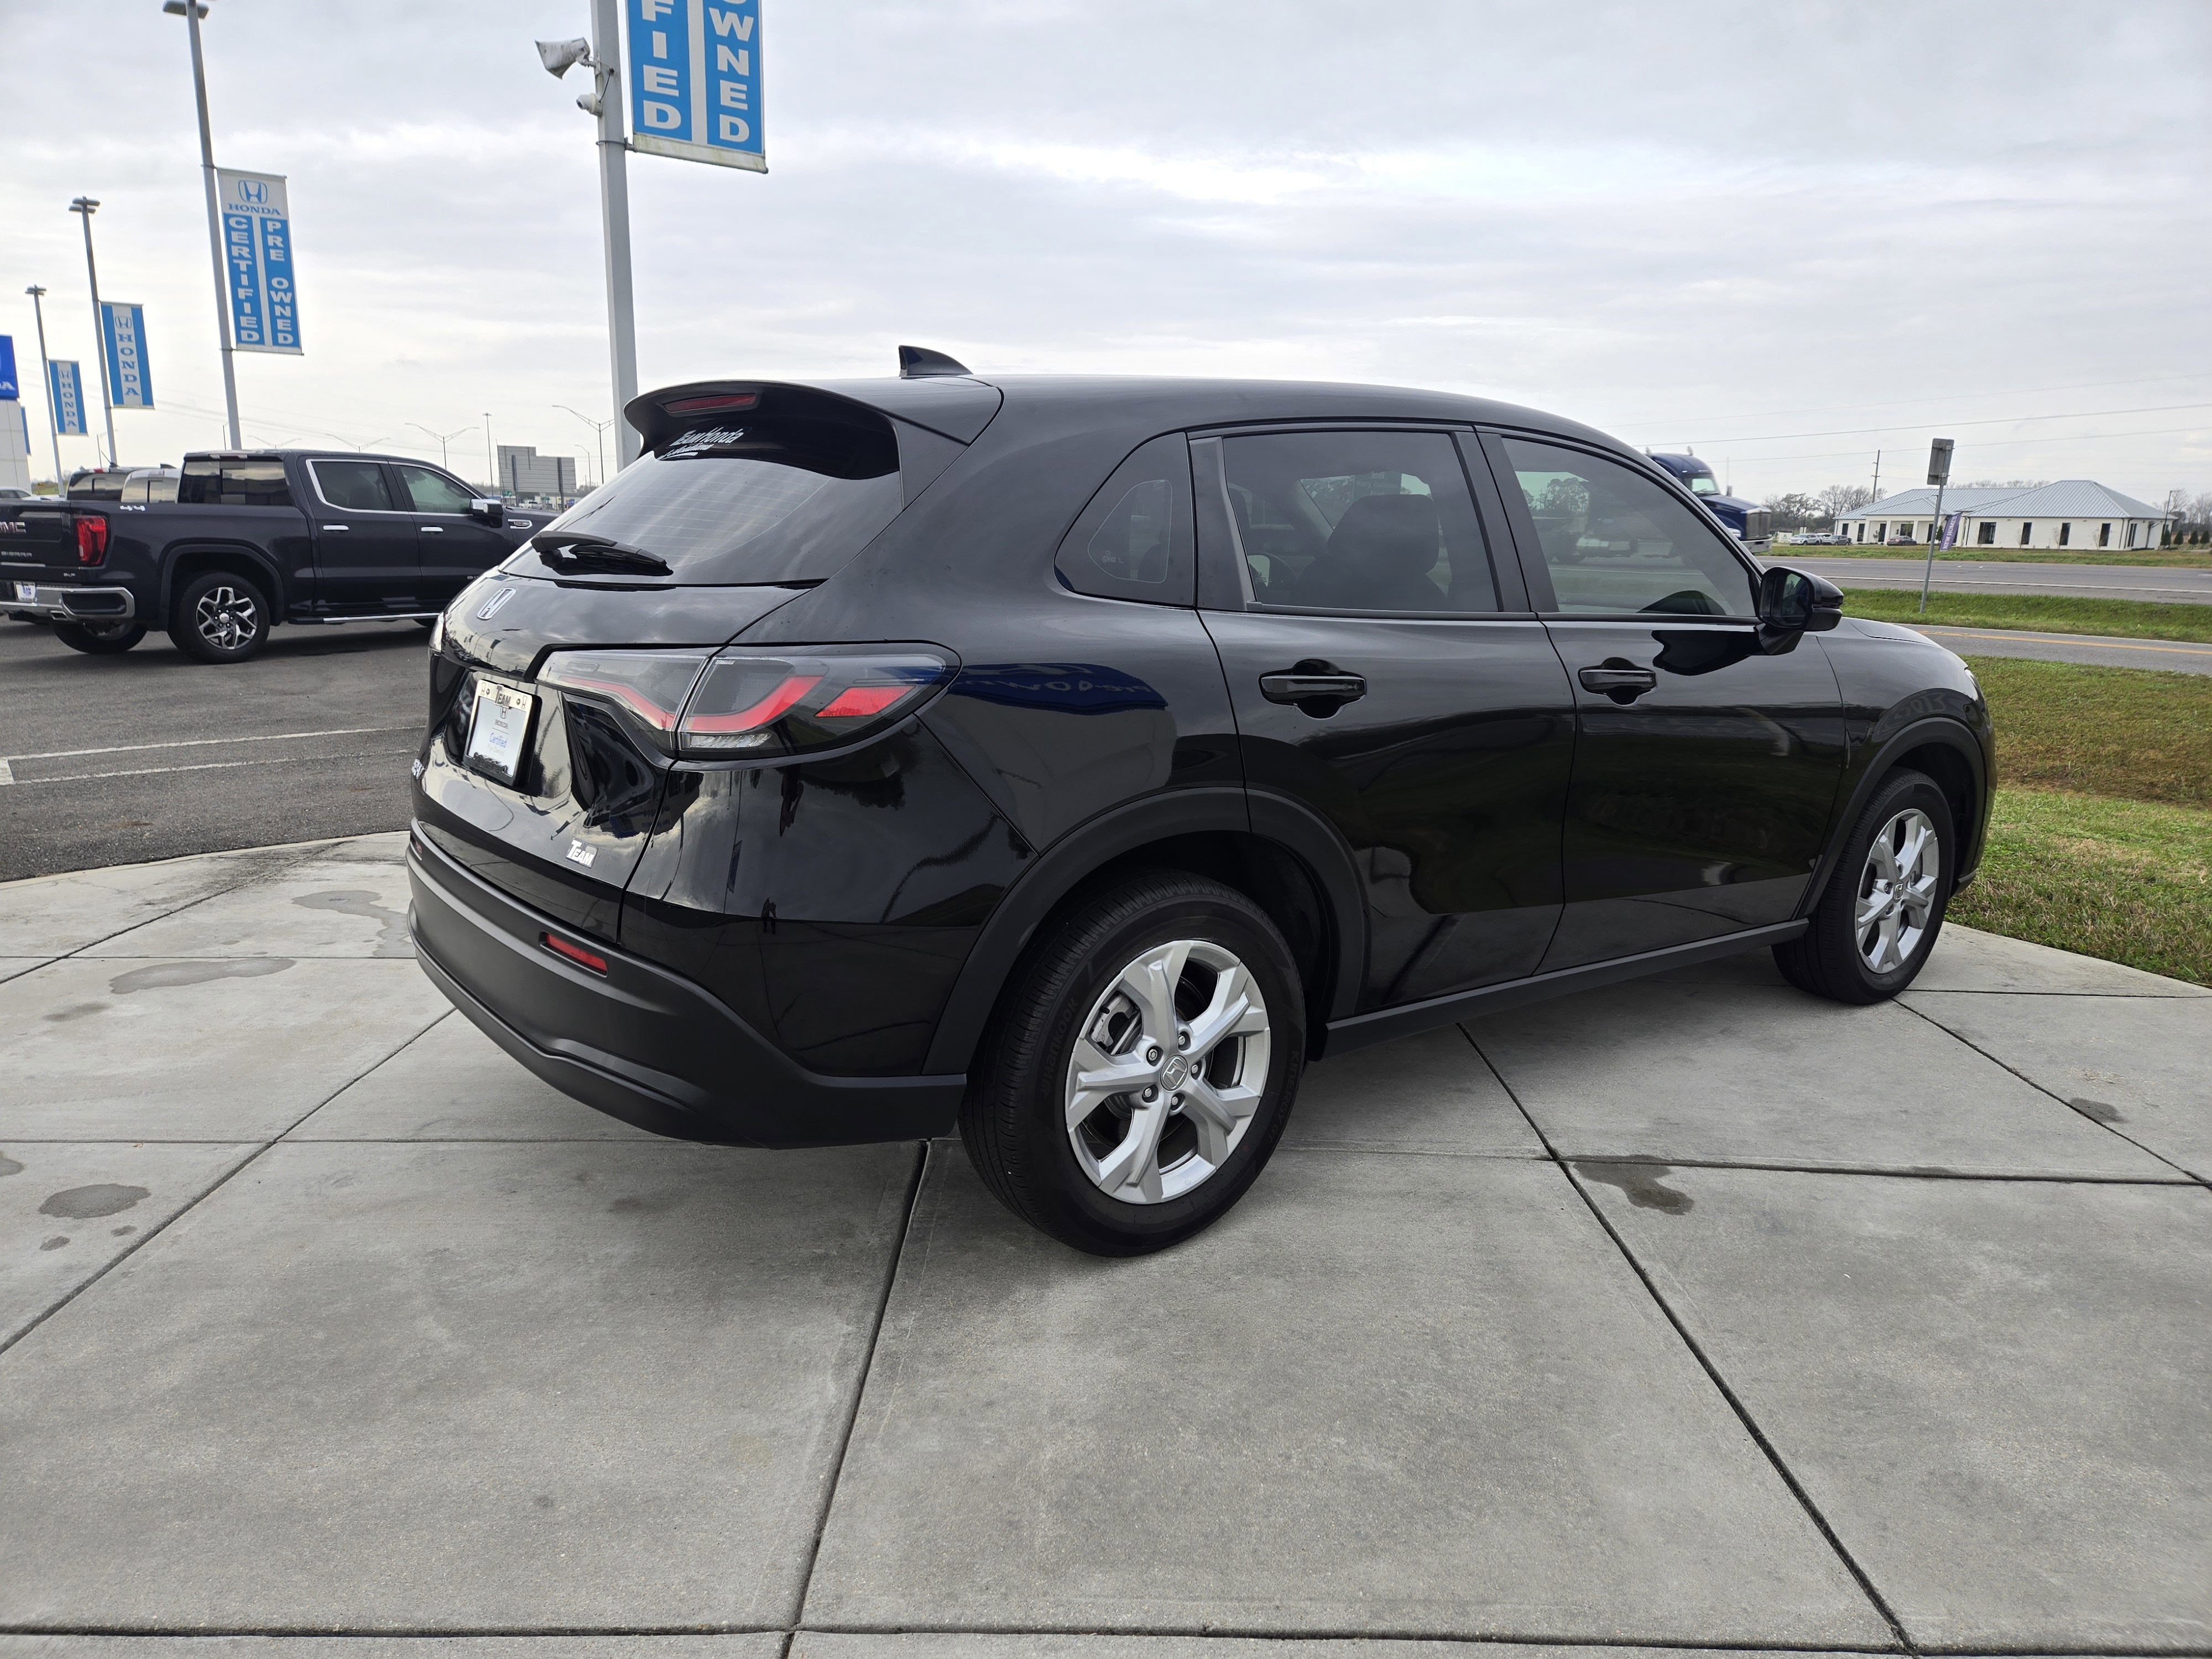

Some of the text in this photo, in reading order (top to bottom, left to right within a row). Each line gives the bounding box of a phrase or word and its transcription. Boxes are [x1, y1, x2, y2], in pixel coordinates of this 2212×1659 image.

[709, 0, 754, 142] WNED
[228, 203, 281, 215] HONDA
[228, 217, 259, 342] CERTIFIED
[267, 221, 294, 346] PRE OWNED
[117, 332, 140, 396] HONDA
[61, 382, 77, 427] HONDA
[0, 521, 27, 534] MC
[1942, 516, 1957, 549] NEW HOMES
[494, 685, 512, 708] TEAM
[566, 839, 594, 866] TEAM
[1044, 997, 1079, 1079] Hankook
